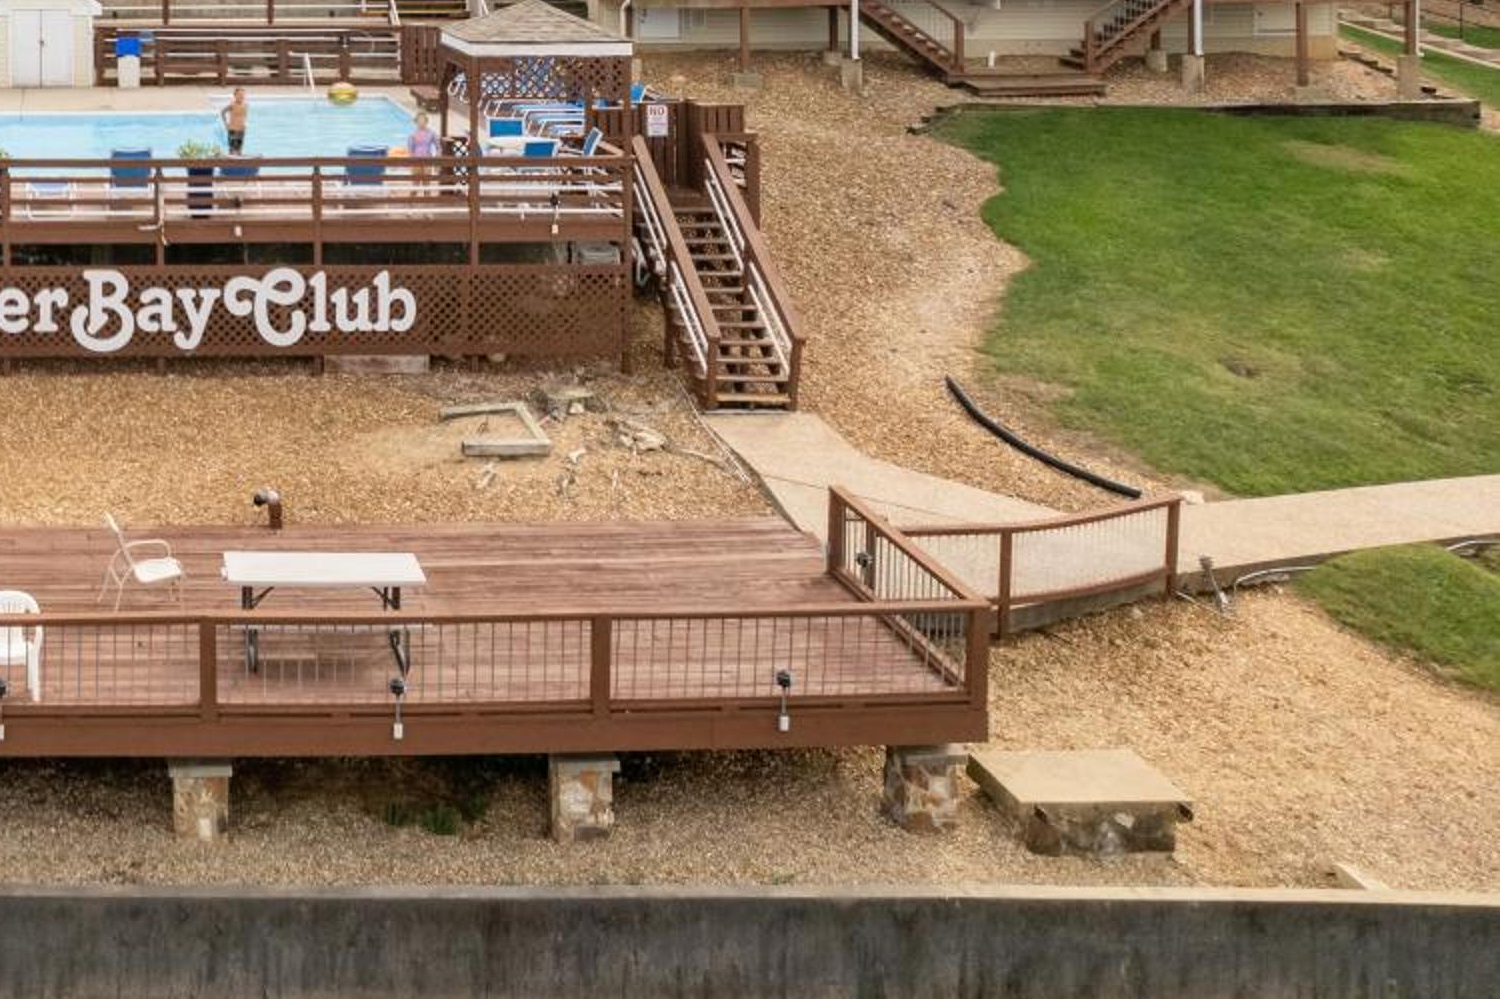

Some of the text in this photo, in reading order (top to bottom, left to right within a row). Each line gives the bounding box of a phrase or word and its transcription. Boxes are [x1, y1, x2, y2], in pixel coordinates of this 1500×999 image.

[649, 105, 665, 116] NO
[70, 268, 221, 352] Bay
[223, 267, 417, 347] Club
